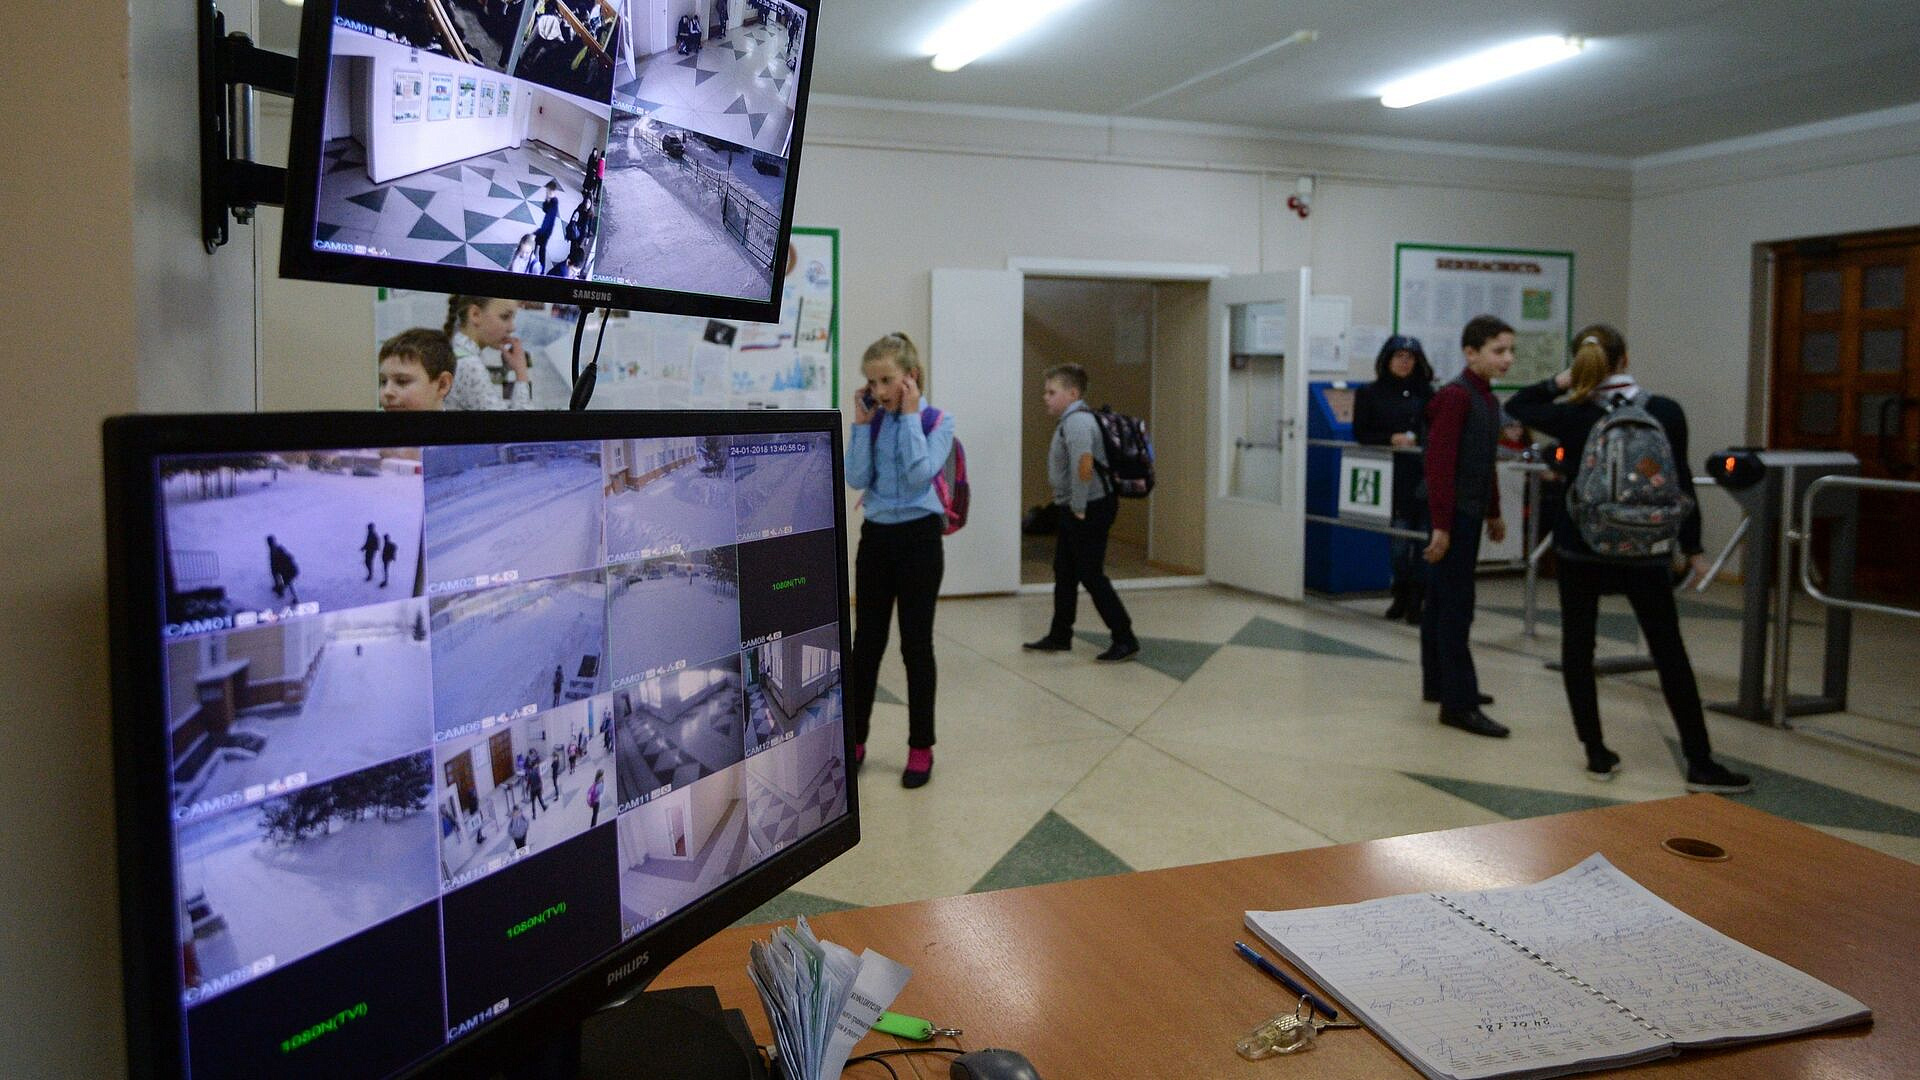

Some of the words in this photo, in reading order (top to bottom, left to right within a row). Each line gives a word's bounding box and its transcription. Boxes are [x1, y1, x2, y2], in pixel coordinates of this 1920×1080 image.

[336, 16, 373, 34] CAM01
[315, 240, 354, 252] CAM03
[572, 289, 612, 301] SAMSUNG
[730, 445, 768, 455] 24-01-2018
[607, 550, 640, 563] CAM03
[772, 577, 806, 590] 1080N(TVI)
[167, 614, 232, 636] CAM01
[741, 636, 765, 650] CAM08
[612, 672, 644, 688] CAM07
[436, 721, 480, 741] CAM06
[745, 740, 769, 757] CAM12
[618, 793, 648, 813] CAM11
[506, 901, 567, 939] 1080N(TVI)
[607, 951, 650, 987] PHILIPS
[281, 1001, 368, 1054] 1080N(TVI)
[449, 1007, 493, 1039] CAM14
